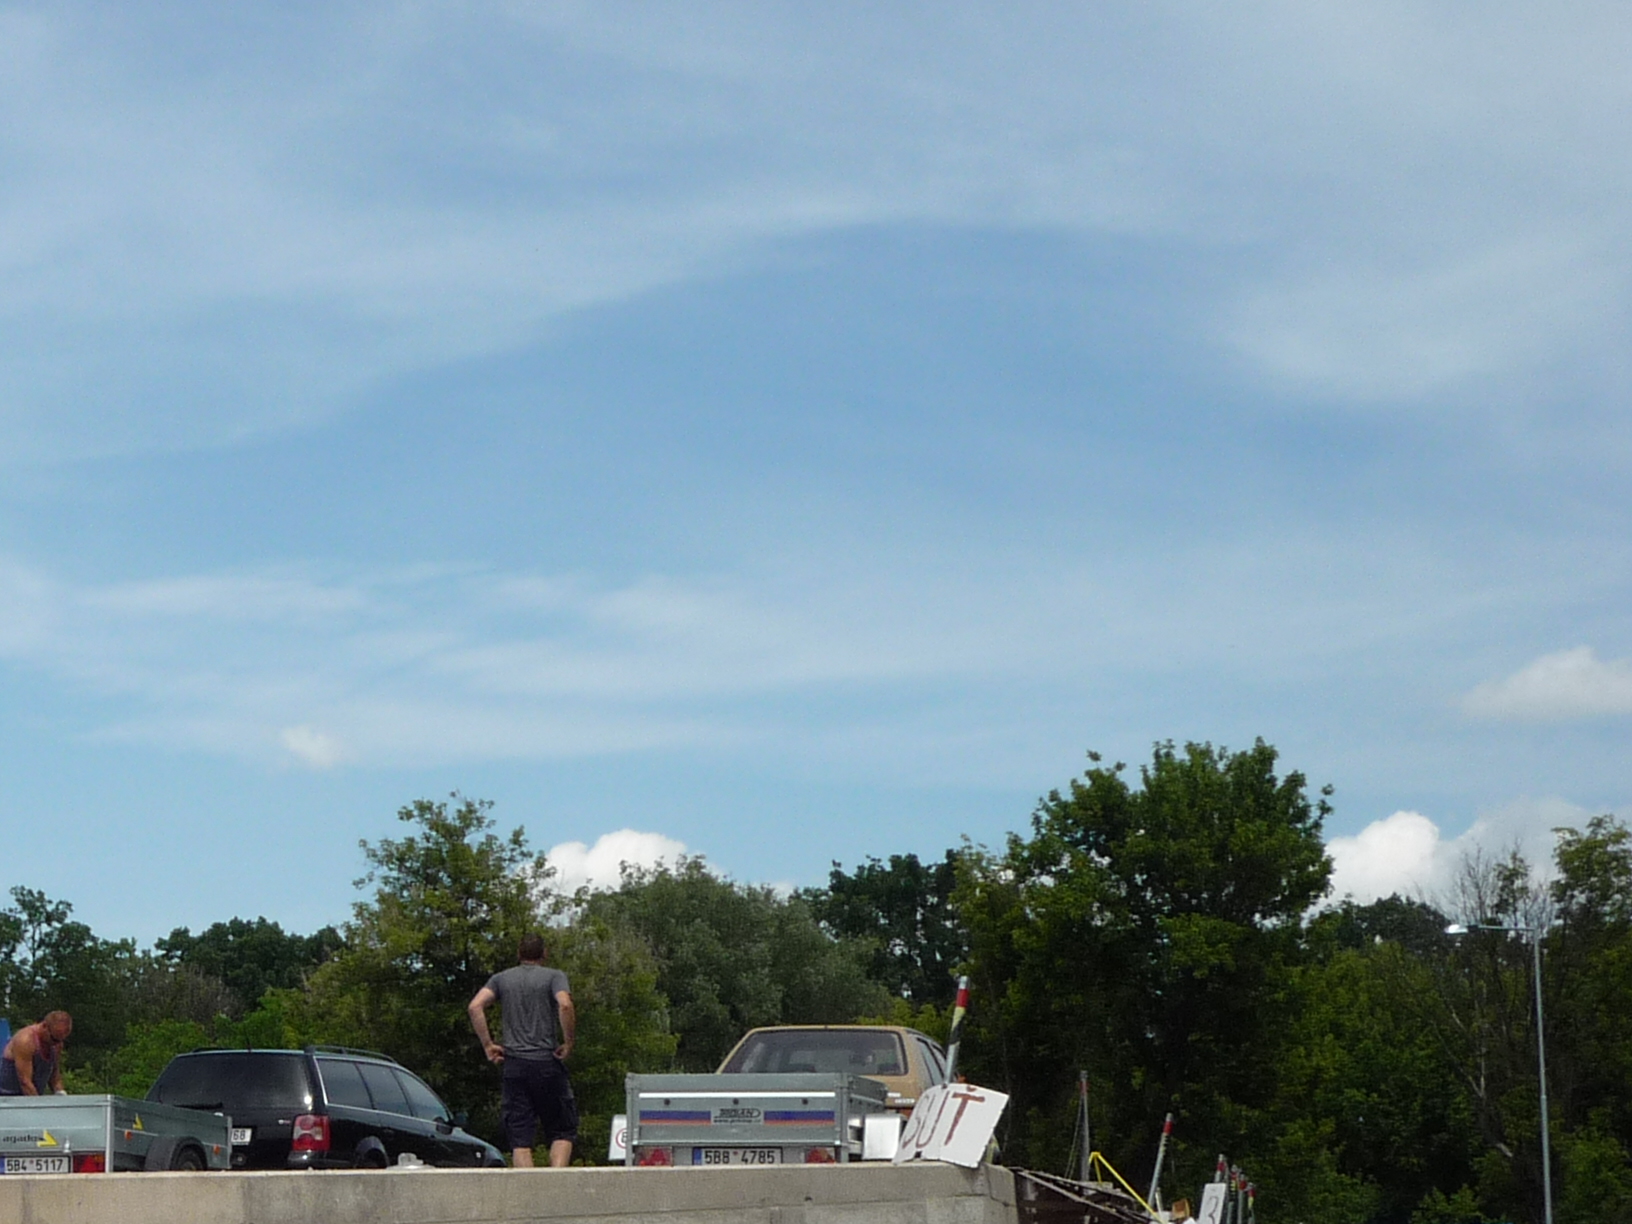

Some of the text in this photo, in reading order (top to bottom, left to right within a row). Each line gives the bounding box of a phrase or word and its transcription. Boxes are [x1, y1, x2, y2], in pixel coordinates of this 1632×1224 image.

[705, 1150, 775, 1165] 5B8 4785
[6, 1159, 64, 1172] 5B4 5117
